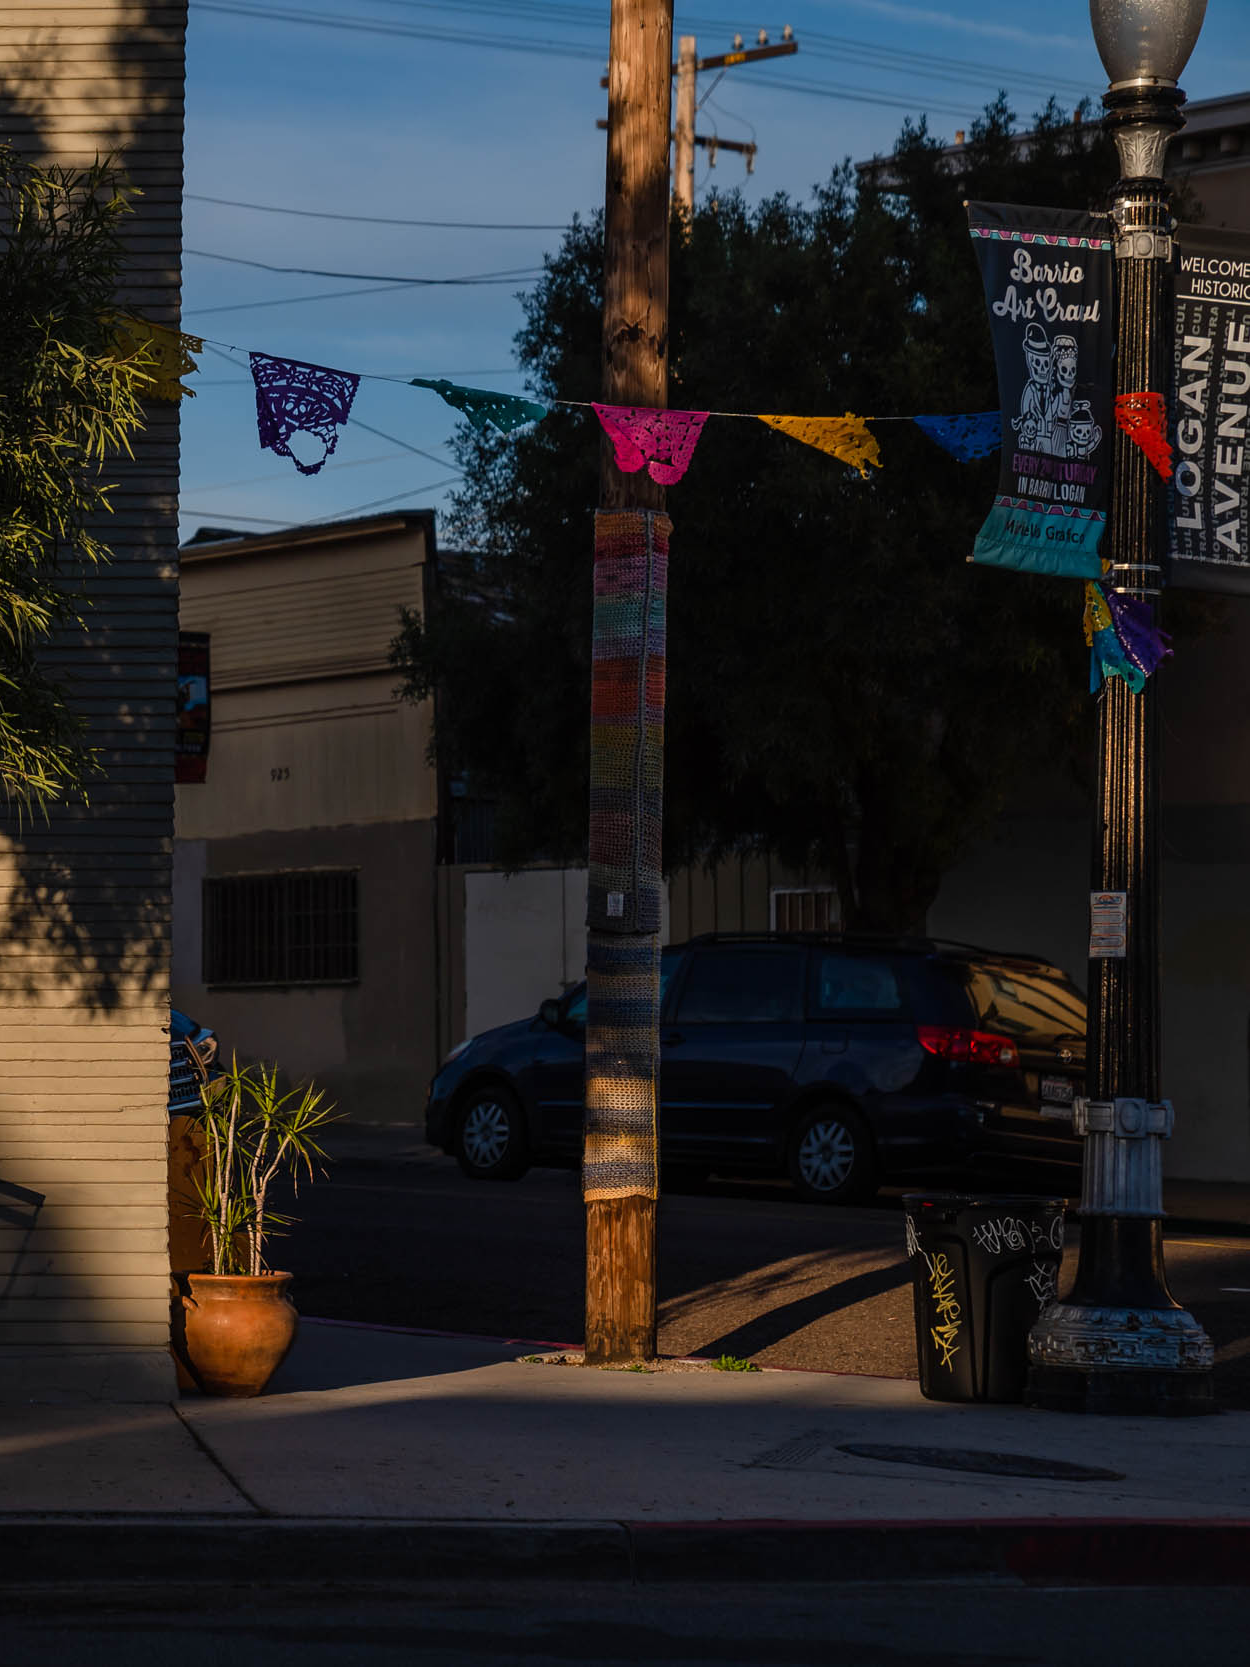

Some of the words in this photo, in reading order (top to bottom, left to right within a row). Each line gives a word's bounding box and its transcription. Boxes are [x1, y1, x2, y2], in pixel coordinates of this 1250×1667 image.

[1010, 248, 1085, 284] Barrio
[1180, 255, 1250, 279] WELCOME
[992, 285, 1036, 323] Art
[1036, 287, 1100, 323] Crawl
[1175, 335, 1212, 529] LOGAN
[1214, 321, 1250, 554] AVENUE
[1018, 475, 1028, 494] IN
[1053, 483, 1086, 503] LOGAN
